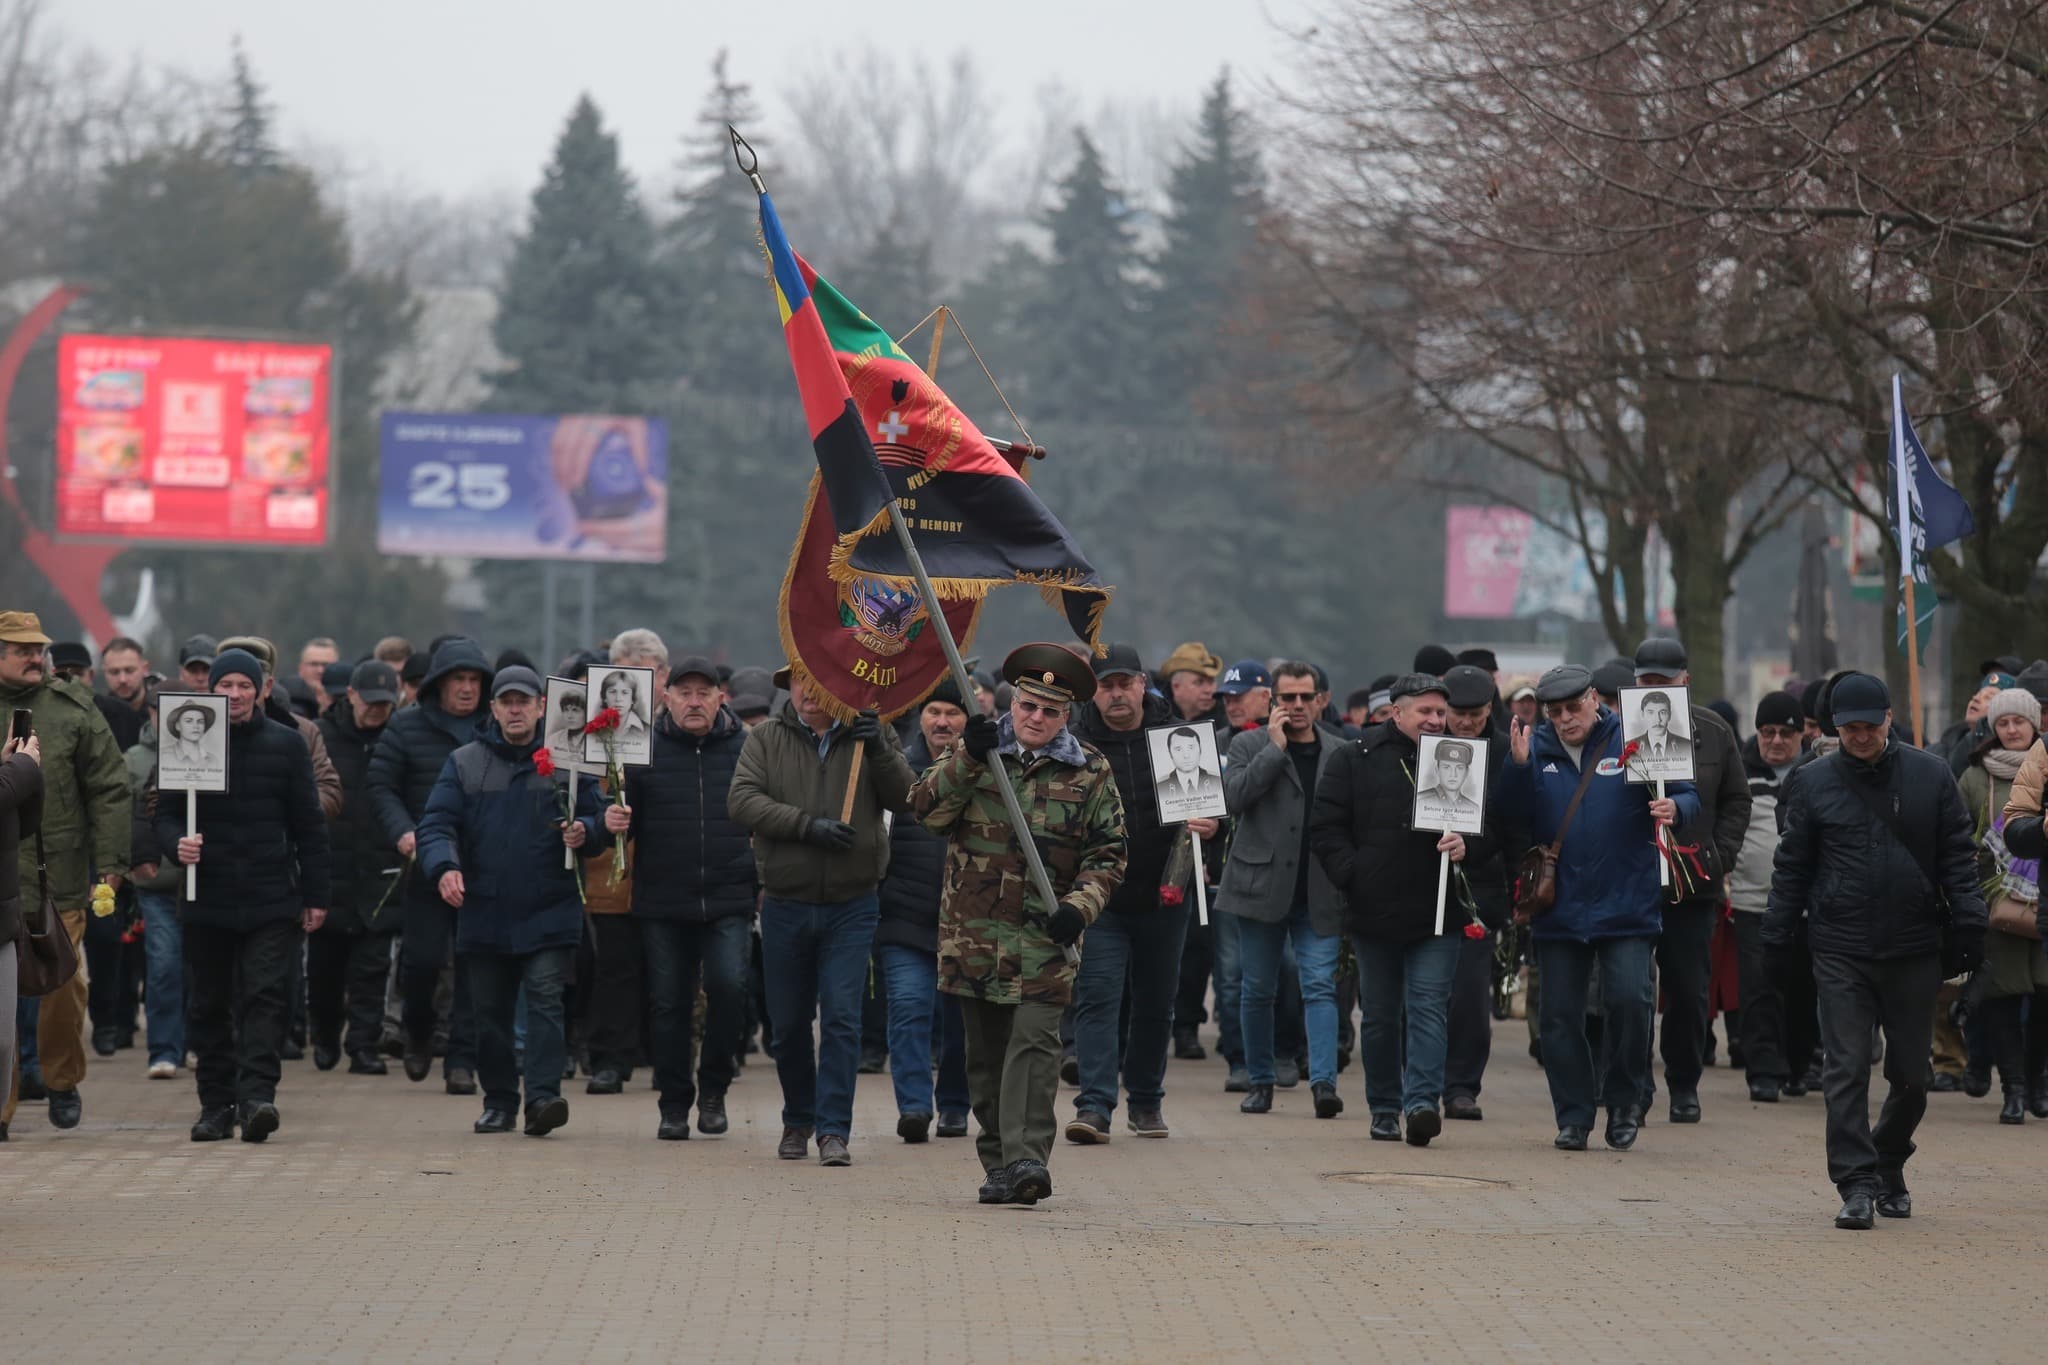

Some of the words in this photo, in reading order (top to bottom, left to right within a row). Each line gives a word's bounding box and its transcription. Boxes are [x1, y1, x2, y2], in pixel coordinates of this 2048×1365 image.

[408, 461, 511, 510] 25
[896, 497, 916, 510] 989
[920, 518, 963, 533] MEMORY
